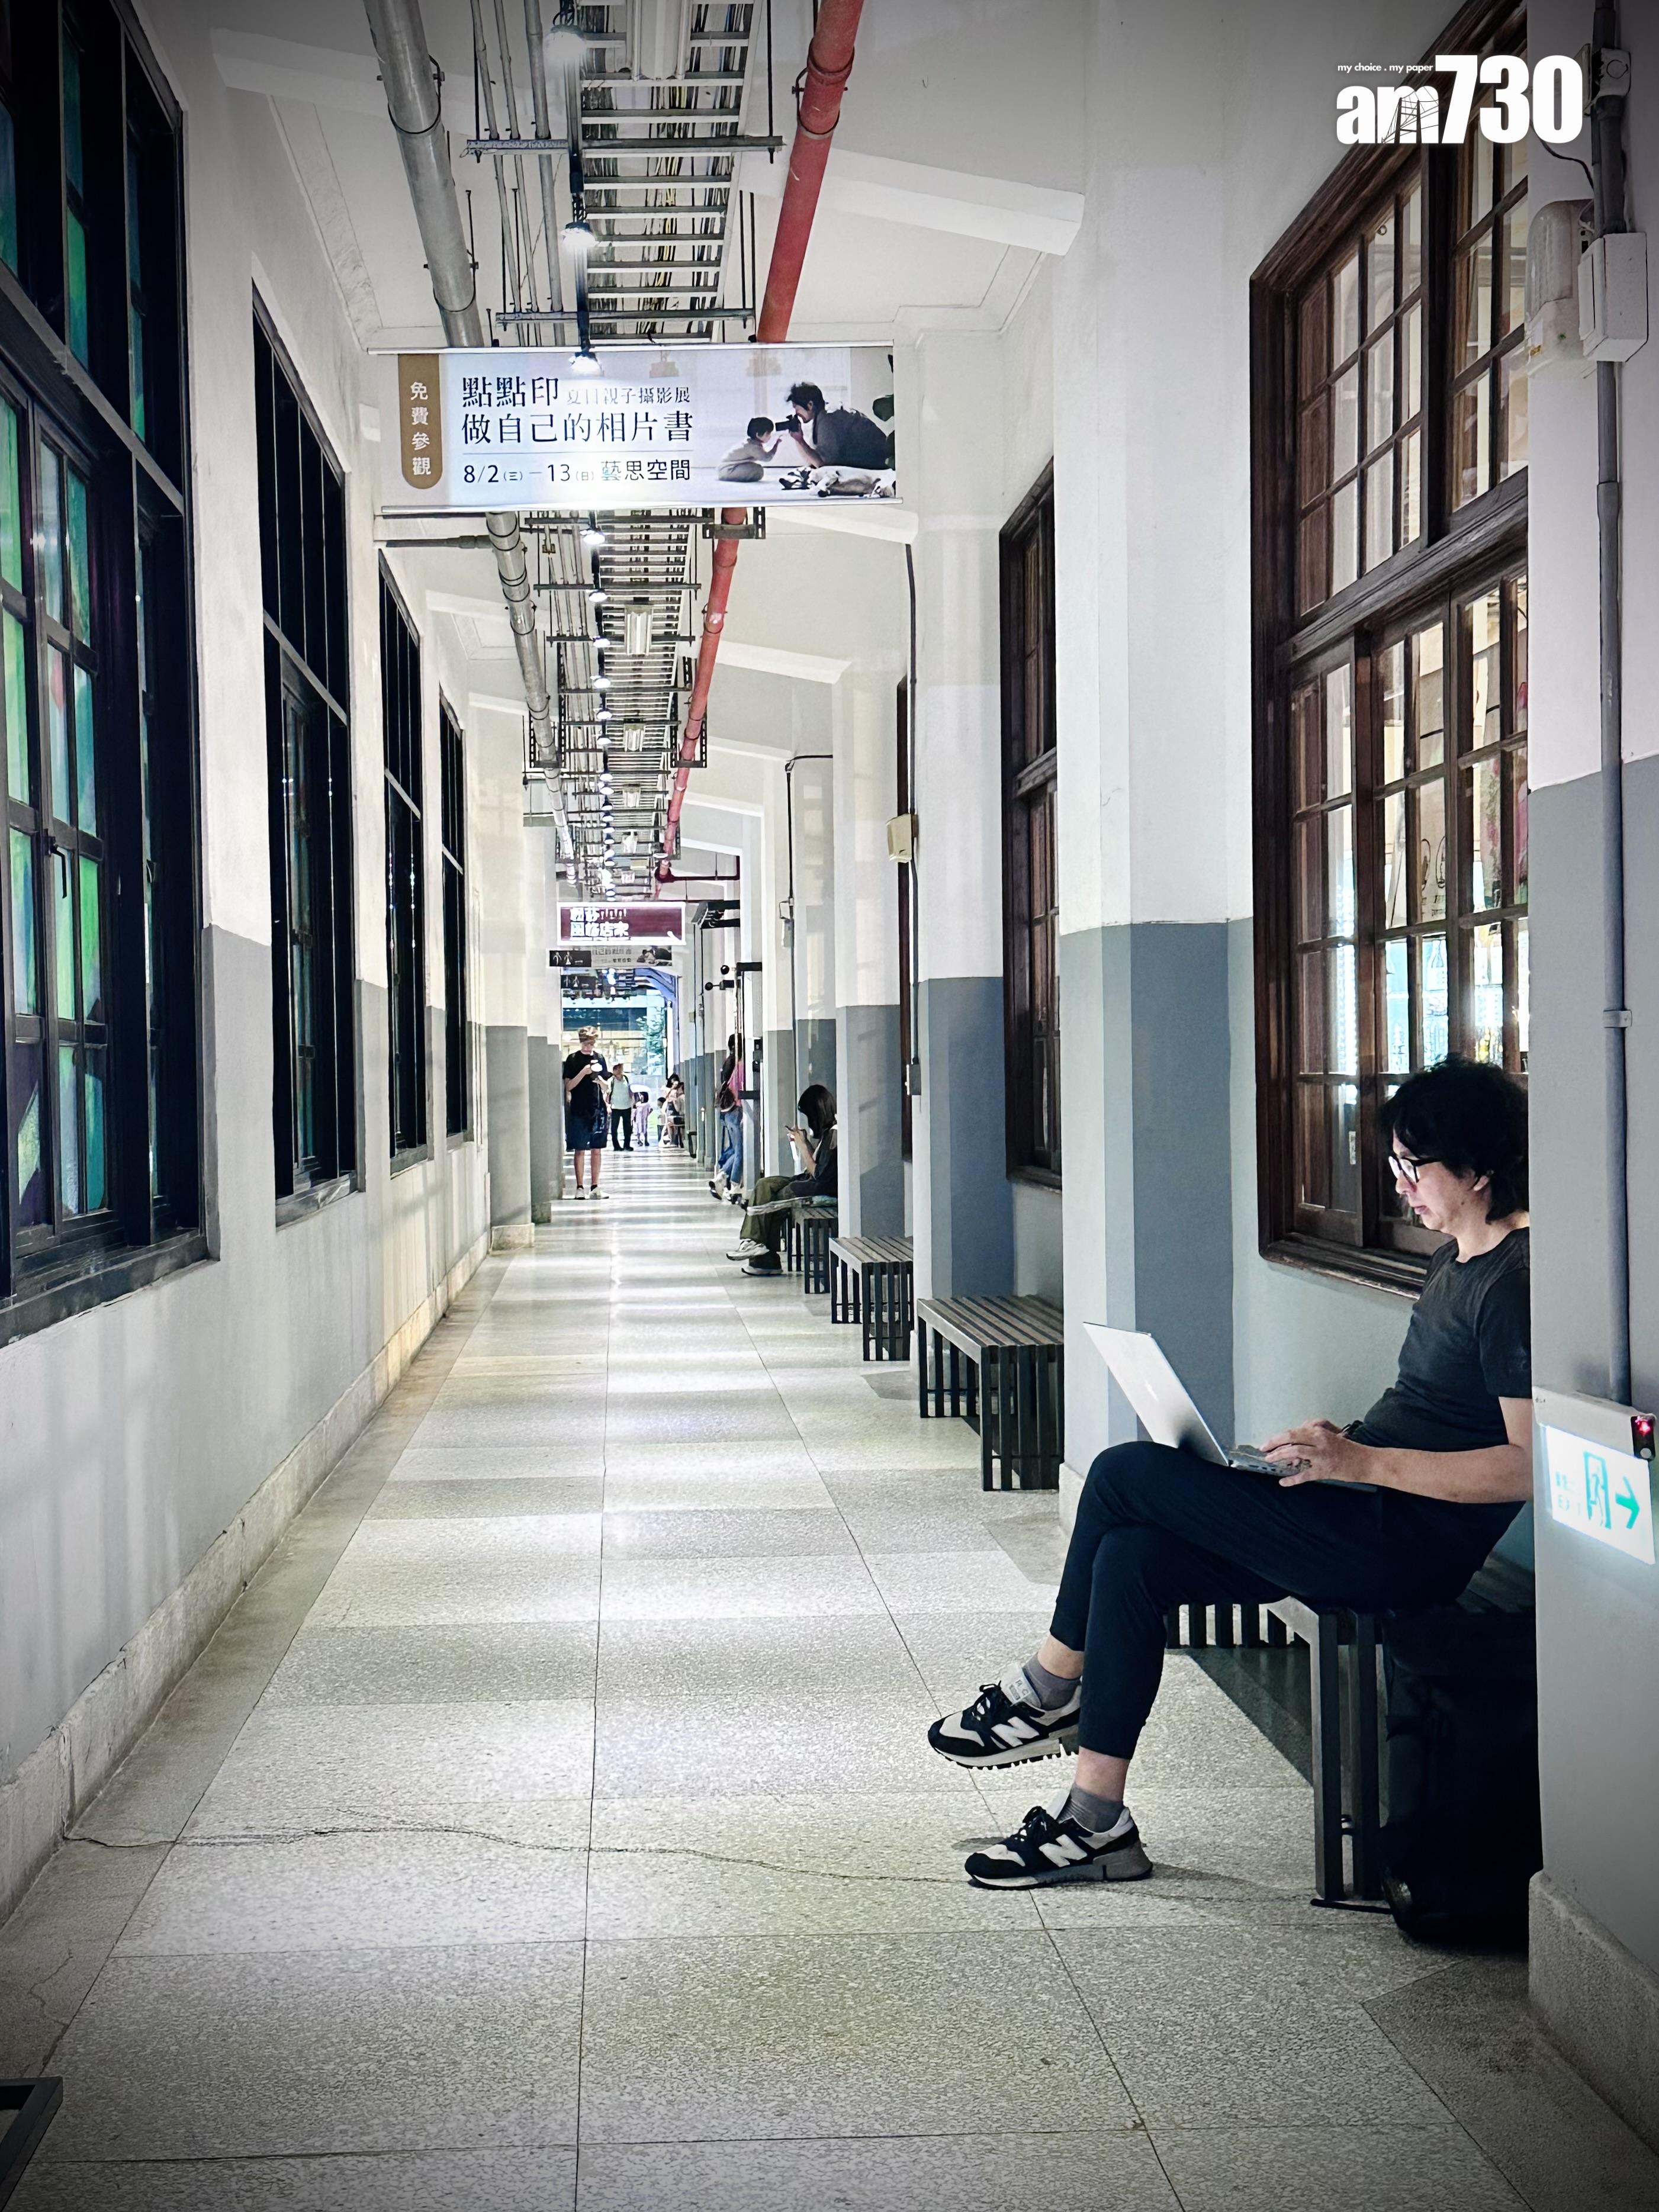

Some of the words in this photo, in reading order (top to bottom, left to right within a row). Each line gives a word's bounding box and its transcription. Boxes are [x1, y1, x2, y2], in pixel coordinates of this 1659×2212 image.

[462, 376, 559, 407] 點點印
[410, 381, 432, 475] 免費參觀
[462, 410, 693, 445] 做自己的相片書
[600, 459, 690, 481] 藝思空間
